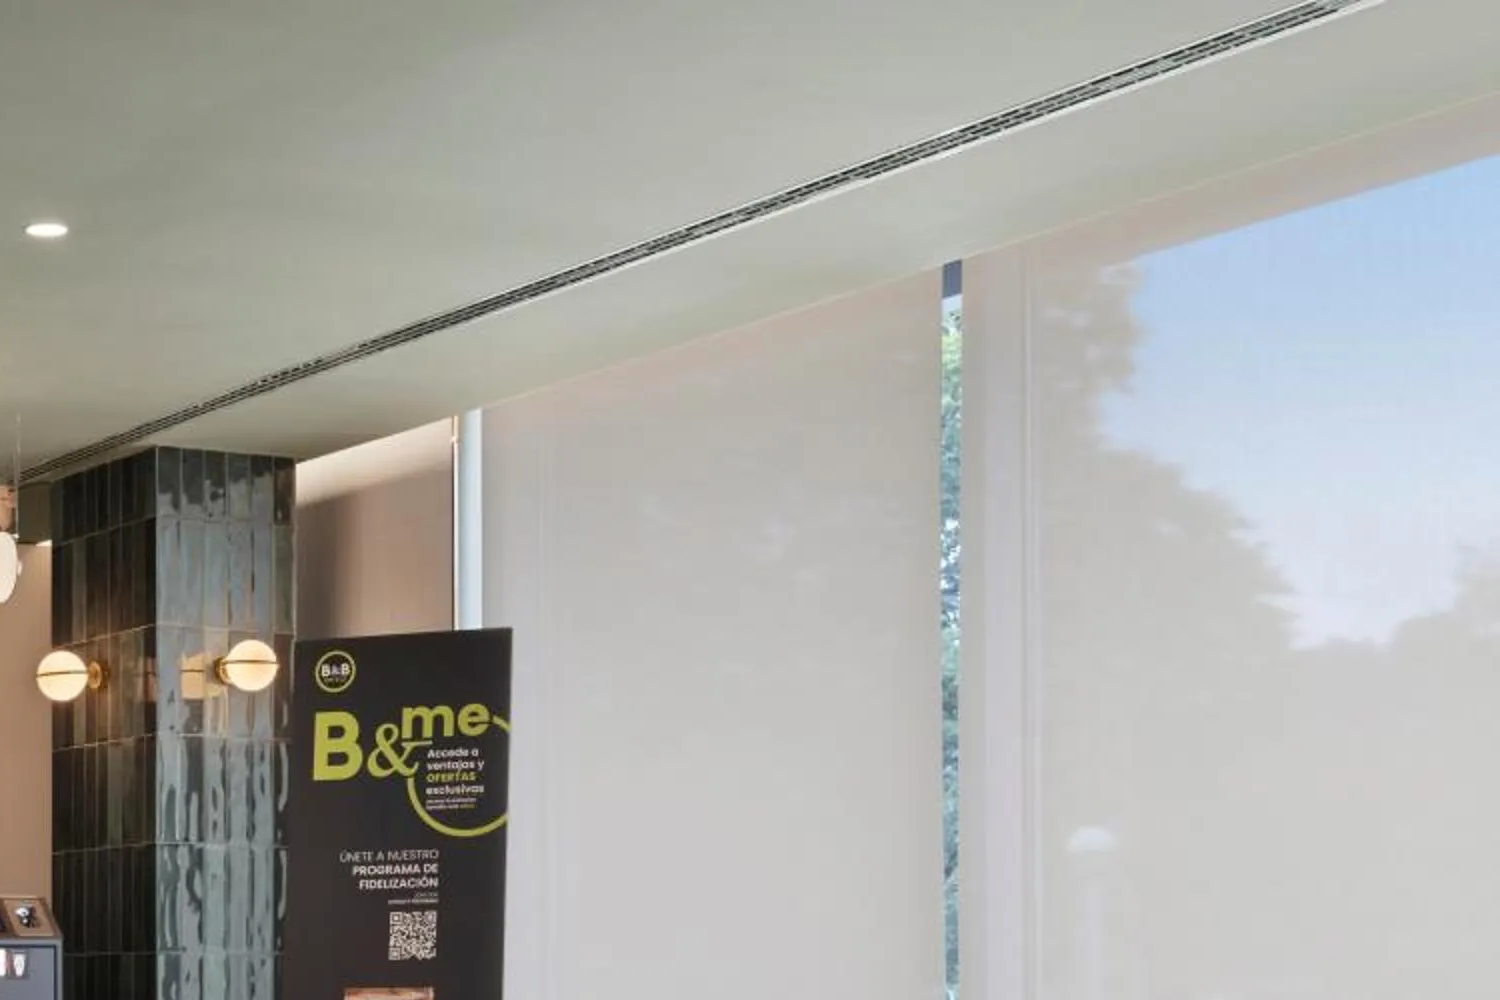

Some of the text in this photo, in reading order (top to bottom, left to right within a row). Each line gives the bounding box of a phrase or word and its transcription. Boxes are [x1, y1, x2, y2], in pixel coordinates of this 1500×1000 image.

[427, 747, 469, 759] Accede
[426, 760, 485, 771] ventajas y
[376, 851, 385, 862] A
[387, 849, 439, 861] NUESTRO
[352, 863, 439, 876] PROGRAMA DE
[359, 876, 439, 890] FIDELIZACIÓN
